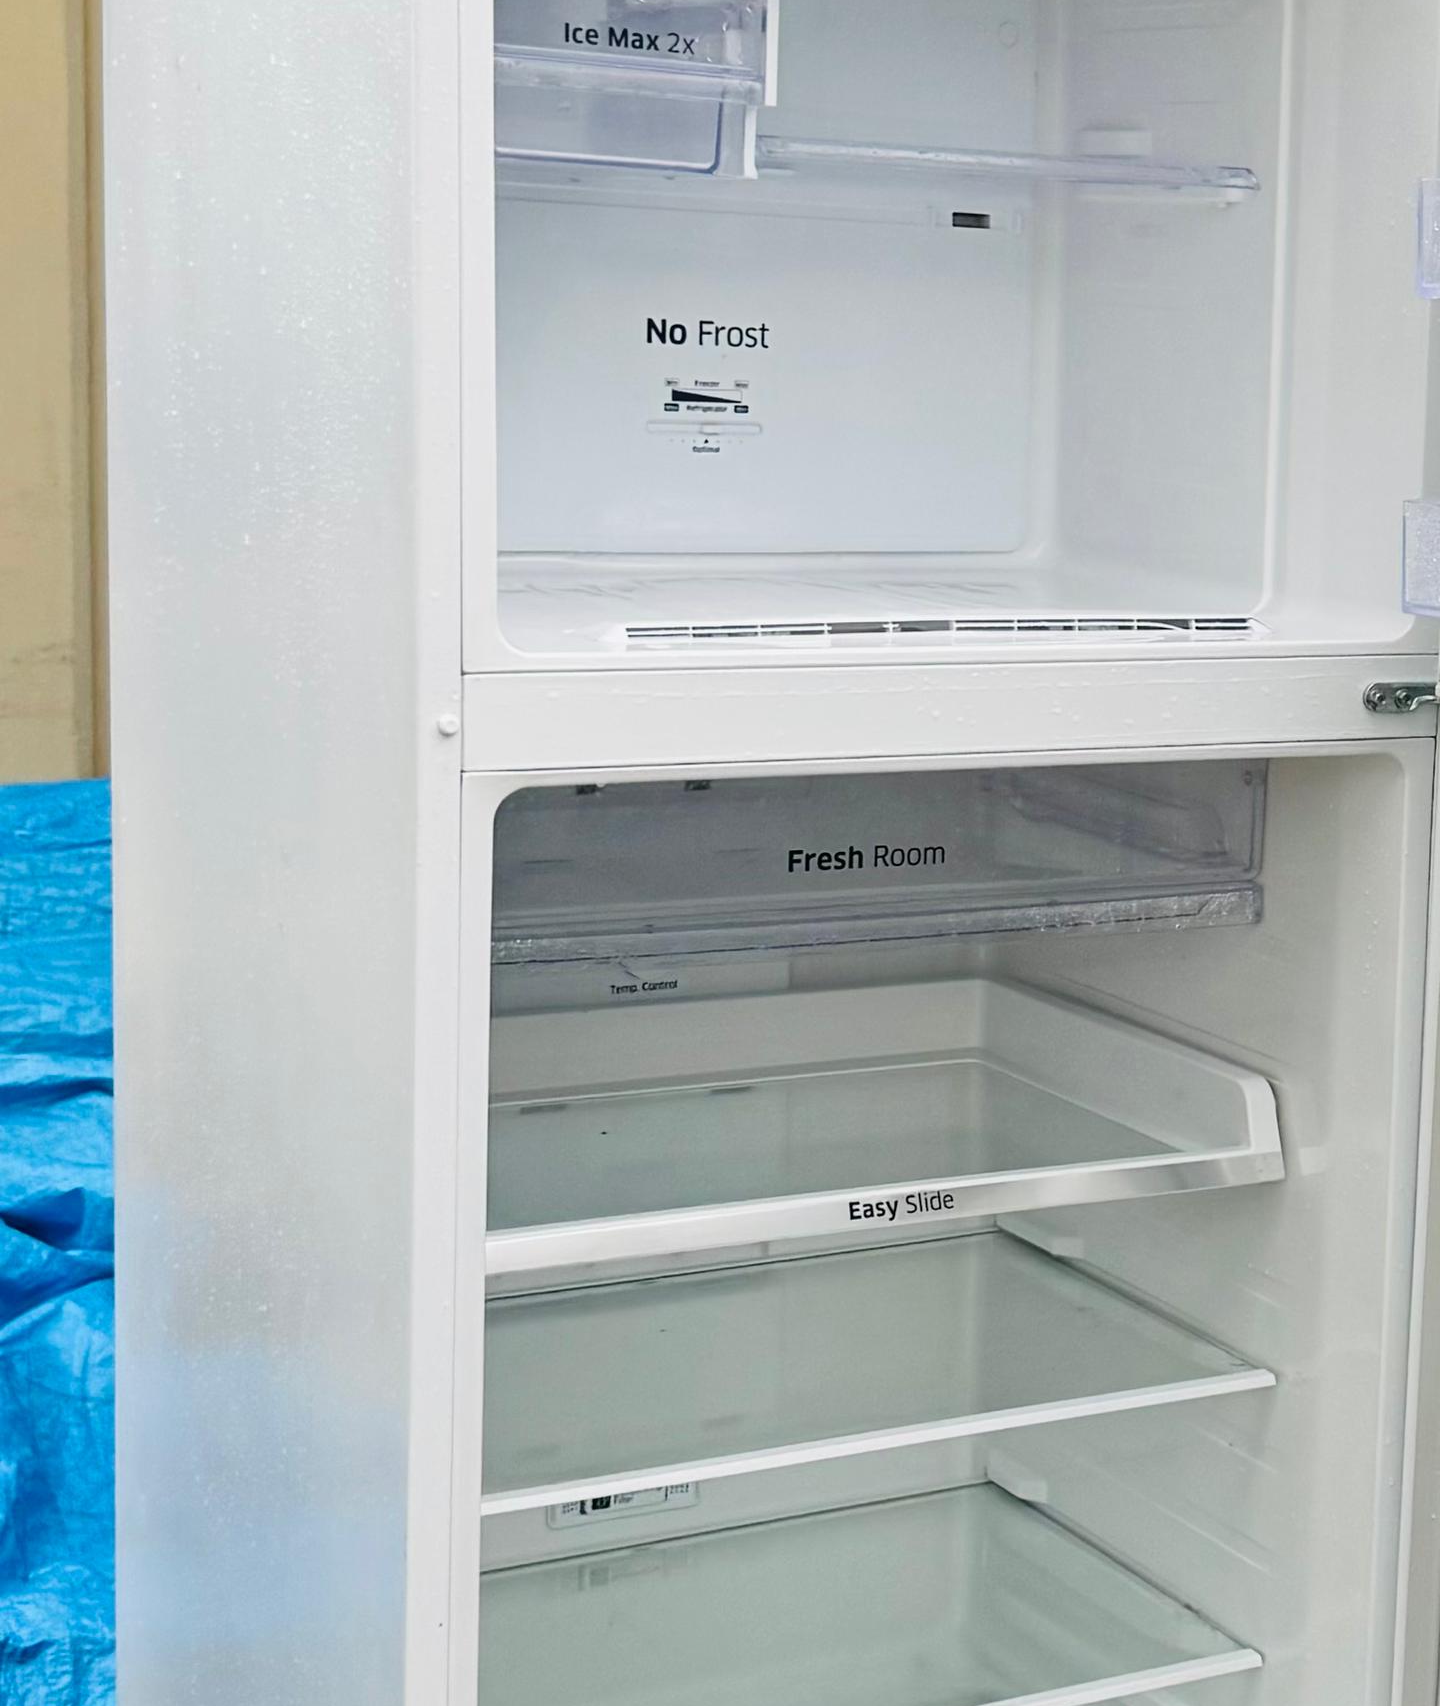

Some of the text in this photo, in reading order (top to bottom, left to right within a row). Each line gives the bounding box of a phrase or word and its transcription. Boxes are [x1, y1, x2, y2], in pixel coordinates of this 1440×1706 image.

[563, 22, 695, 56] Ice Max 2x
[645, 317, 770, 349] No Frost
[787, 844, 946, 874] Fresh Room
[641, 980, 679, 992] Control
[847, 1189, 955, 1223] Easy Slide
